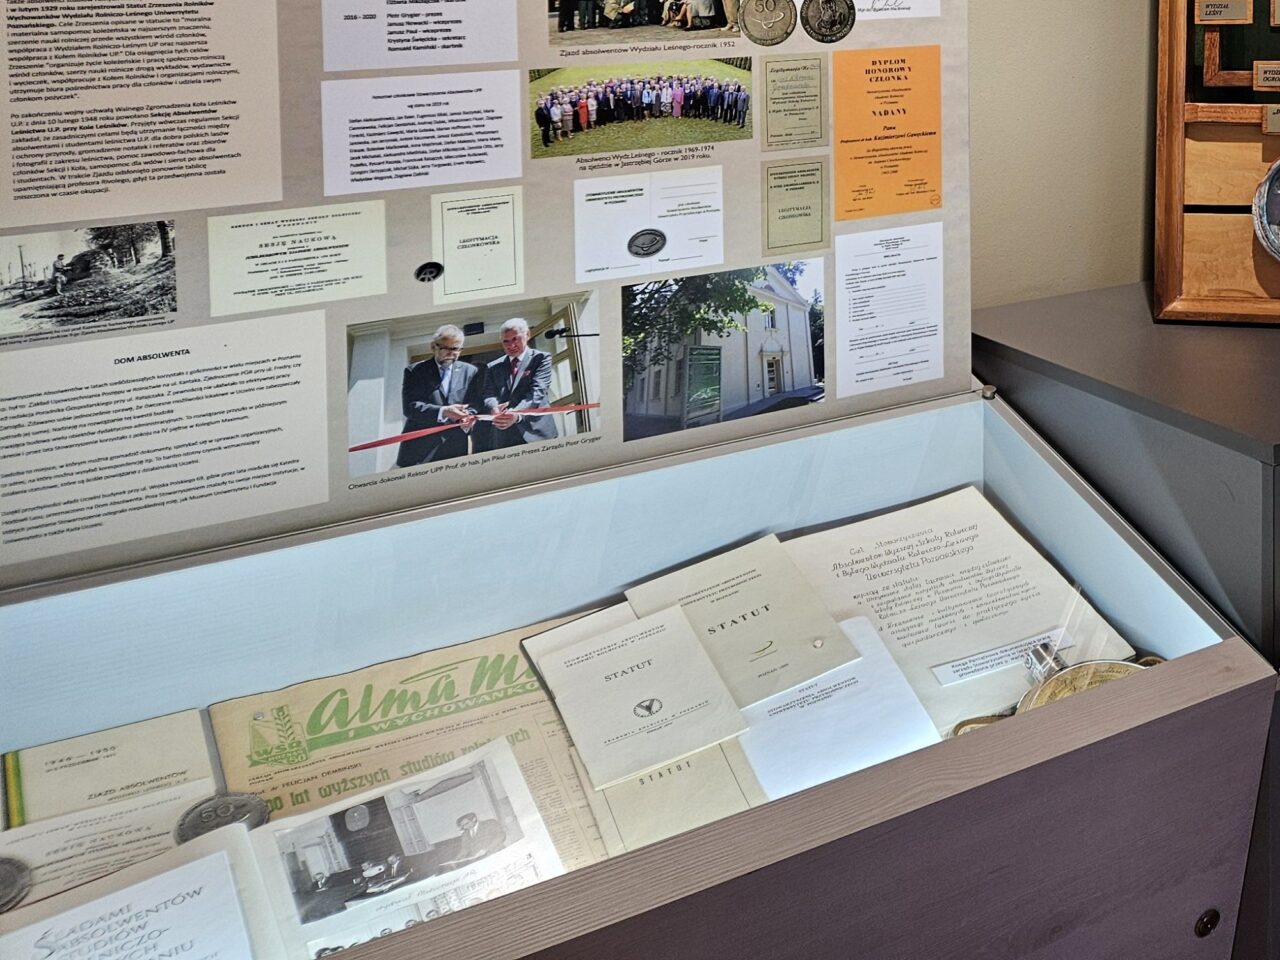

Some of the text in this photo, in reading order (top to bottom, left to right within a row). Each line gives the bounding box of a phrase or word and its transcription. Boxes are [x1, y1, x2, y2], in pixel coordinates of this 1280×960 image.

[865, 66, 912, 75] HONOROWY
[684, 145, 715, 153] 1969-1974
[114, 348, 190, 366] DOM ABSOLWENTA
[708, 603, 772, 635] STATUT
[604, 658, 653, 682] STATUT
[282, 776, 318, 787] FELICJAN
[638, 761, 692, 786] STATUT
[291, 767, 390, 806] lat wyższych
[200, 804, 234, 823] 50
